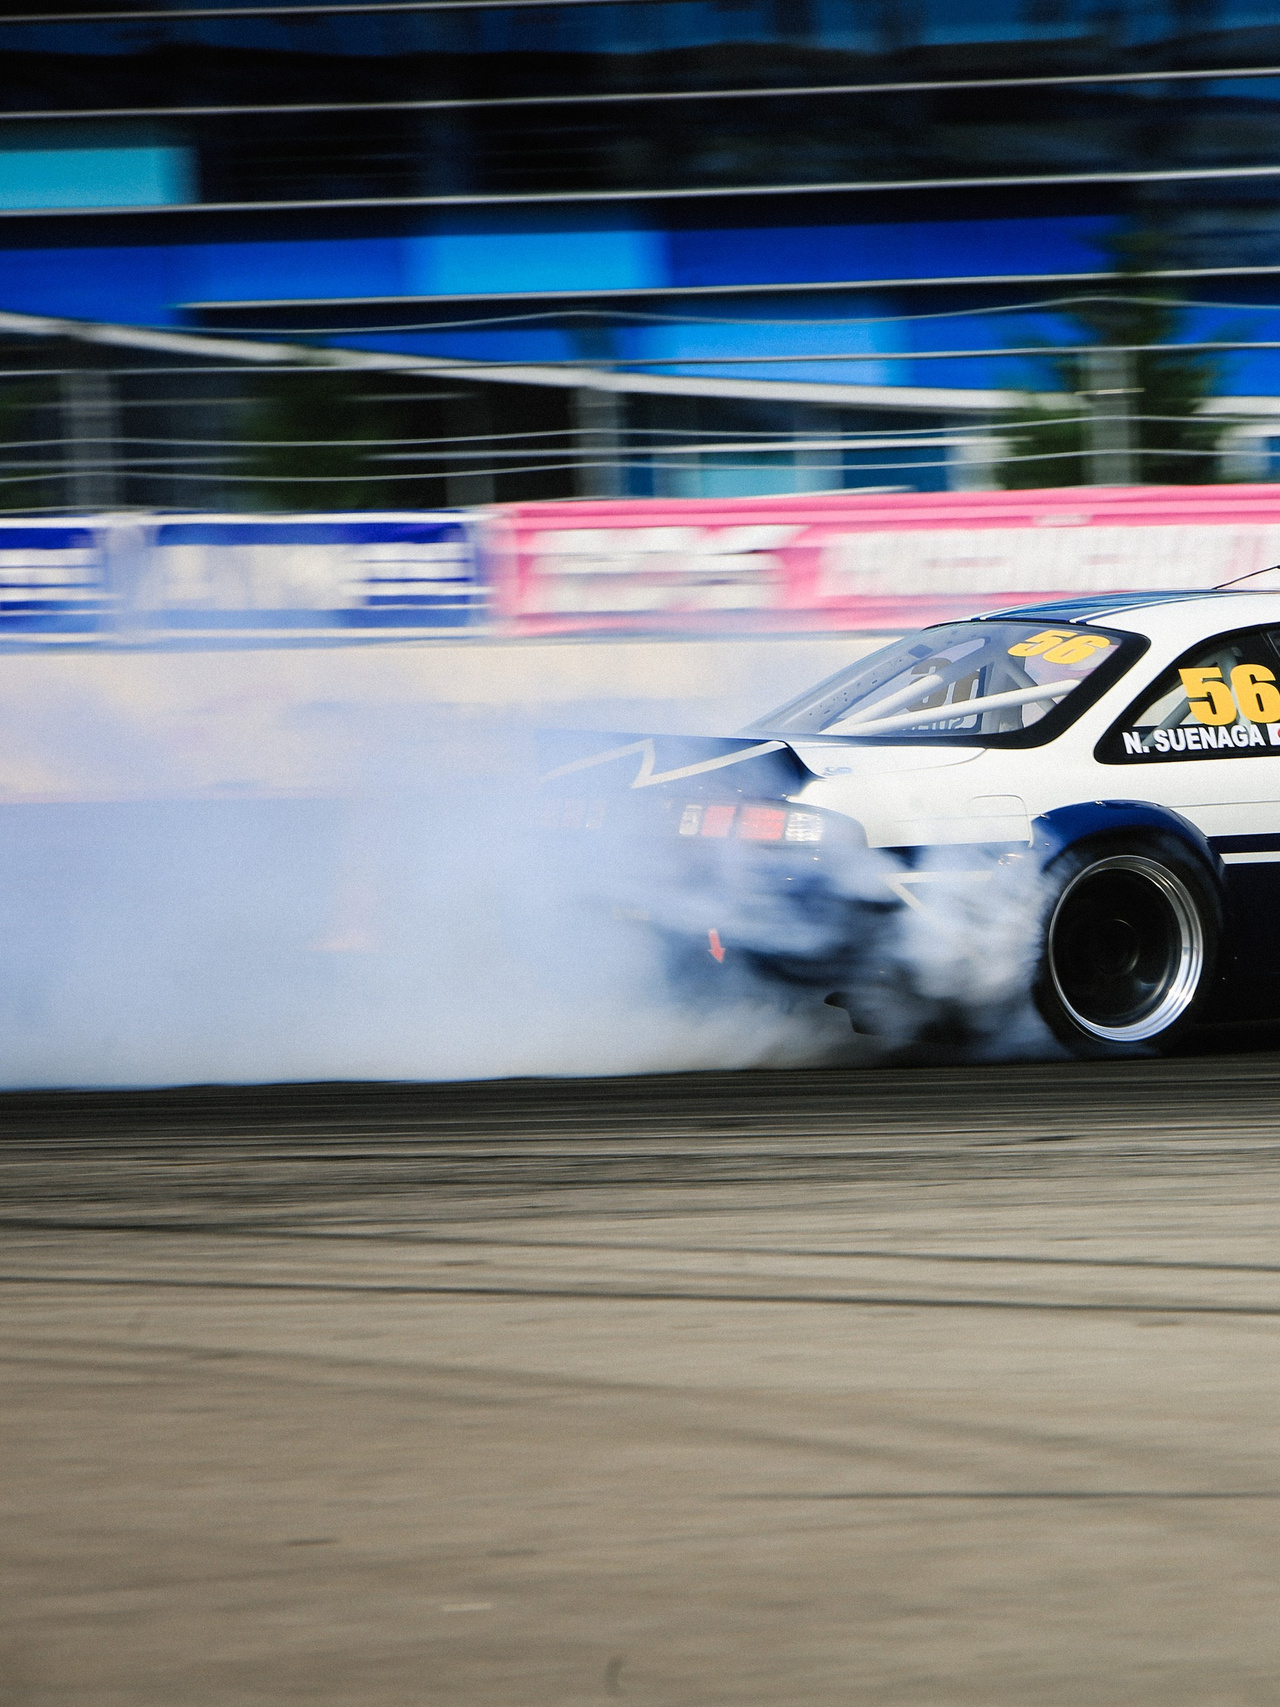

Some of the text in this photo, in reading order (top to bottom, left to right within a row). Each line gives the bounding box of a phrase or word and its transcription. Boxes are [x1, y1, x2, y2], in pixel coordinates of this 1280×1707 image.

[1007, 629, 1111, 665] 56
[1122, 724, 1267, 754] N. SUENAGA
